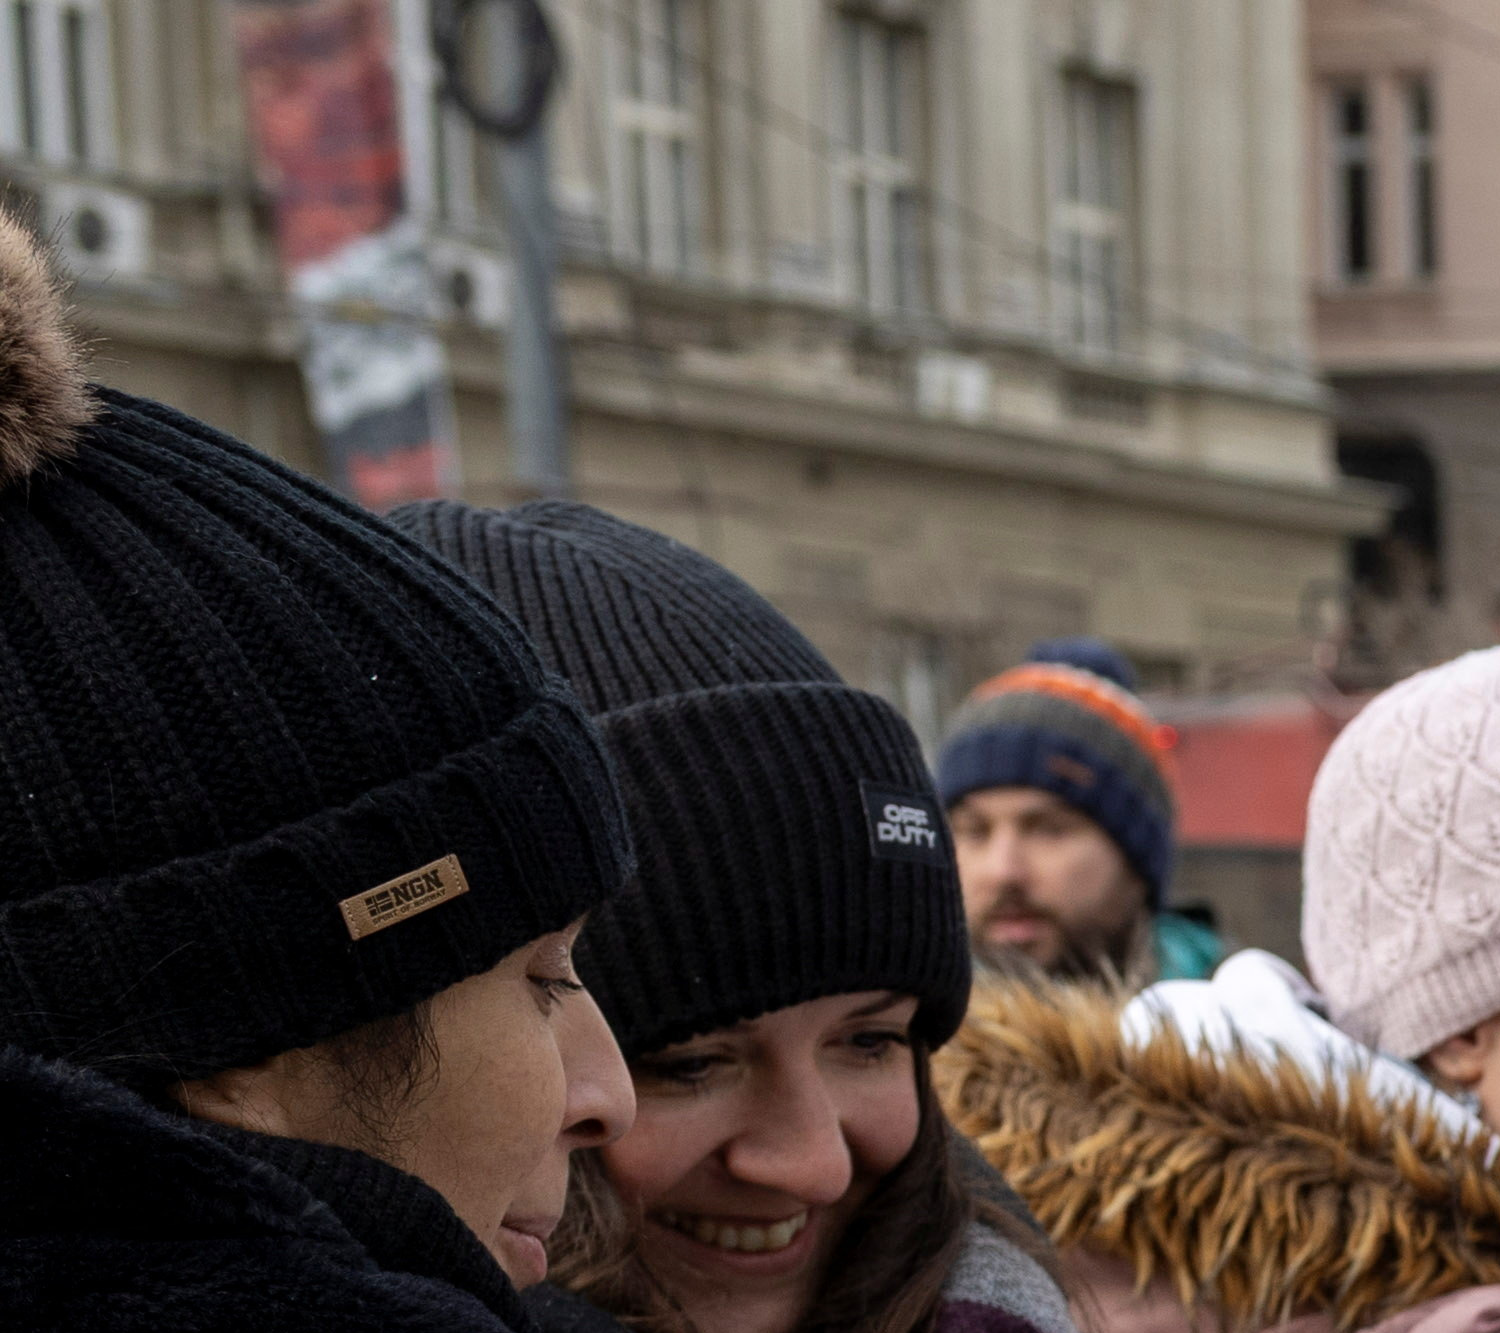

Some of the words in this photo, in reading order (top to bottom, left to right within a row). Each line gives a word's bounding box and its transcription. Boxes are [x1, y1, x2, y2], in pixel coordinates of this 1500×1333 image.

[883, 804, 928, 825] OFF
[877, 822, 936, 849] DUTY
[389, 868, 444, 906] NGN
